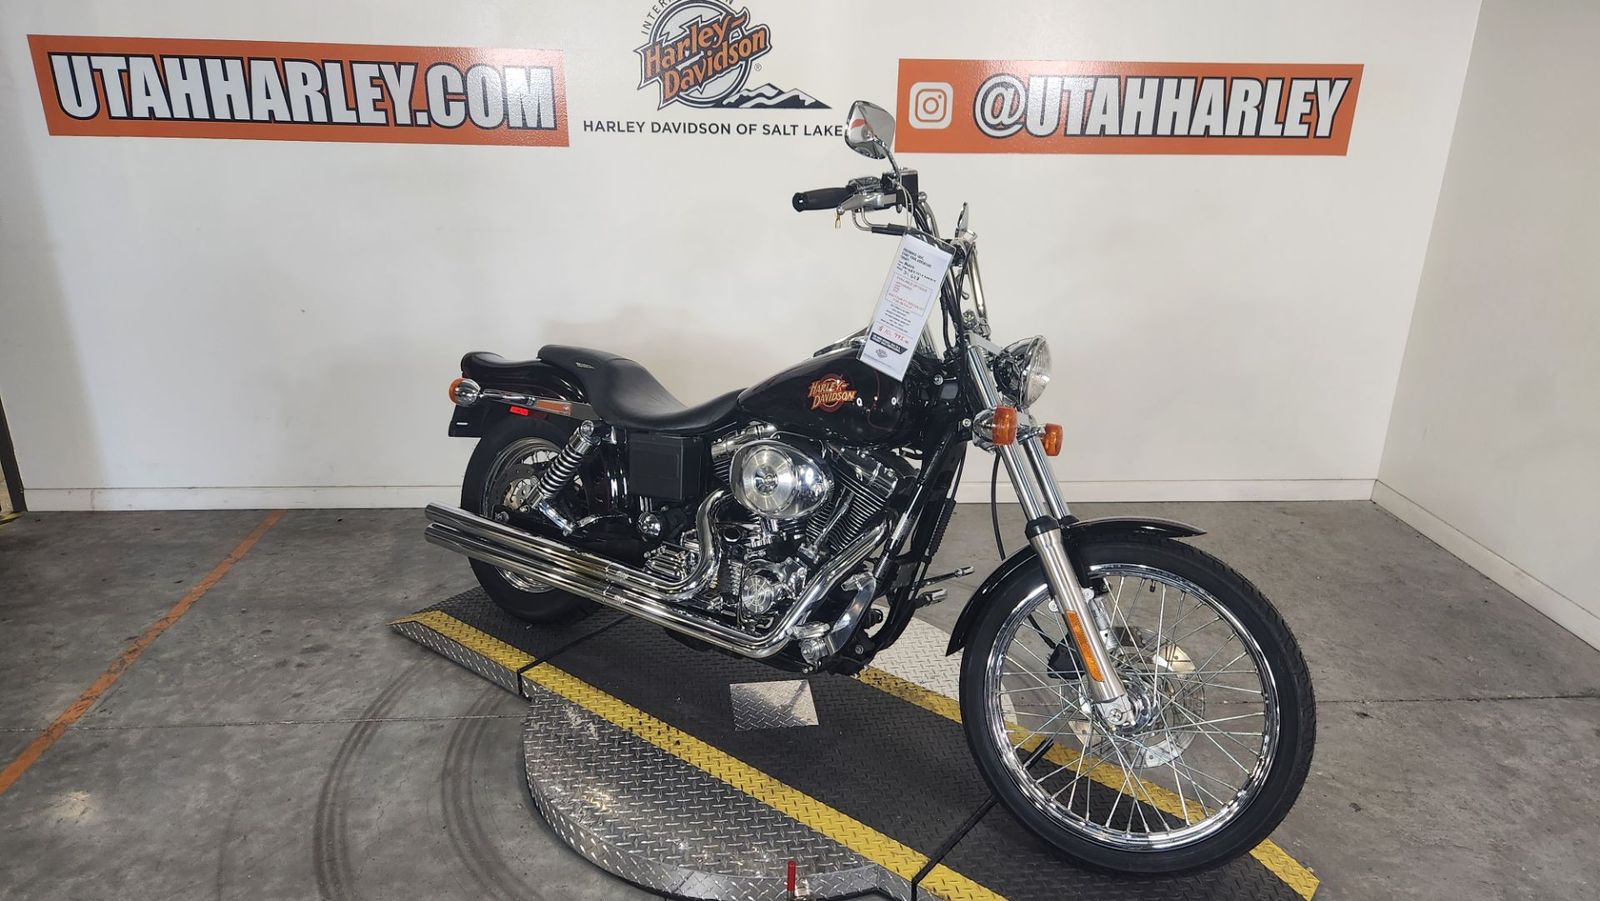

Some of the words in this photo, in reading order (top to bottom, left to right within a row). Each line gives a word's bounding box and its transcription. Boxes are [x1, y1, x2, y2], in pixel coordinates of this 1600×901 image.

[48, 51, 557, 130] UTAHHARLEY.COM
[663, 27, 767, 100] Davidson
[583, 120, 645, 134] HARLEY
[651, 121, 731, 135] DAVIDSON
[736, 123, 757, 135] OF
[762, 124, 799, 136] SALT
[804, 124, 843, 137] LAKE
[972, 73, 1353, 139] @UTAHHARLEY
[811, 390, 857, 410] DAVIDSON
